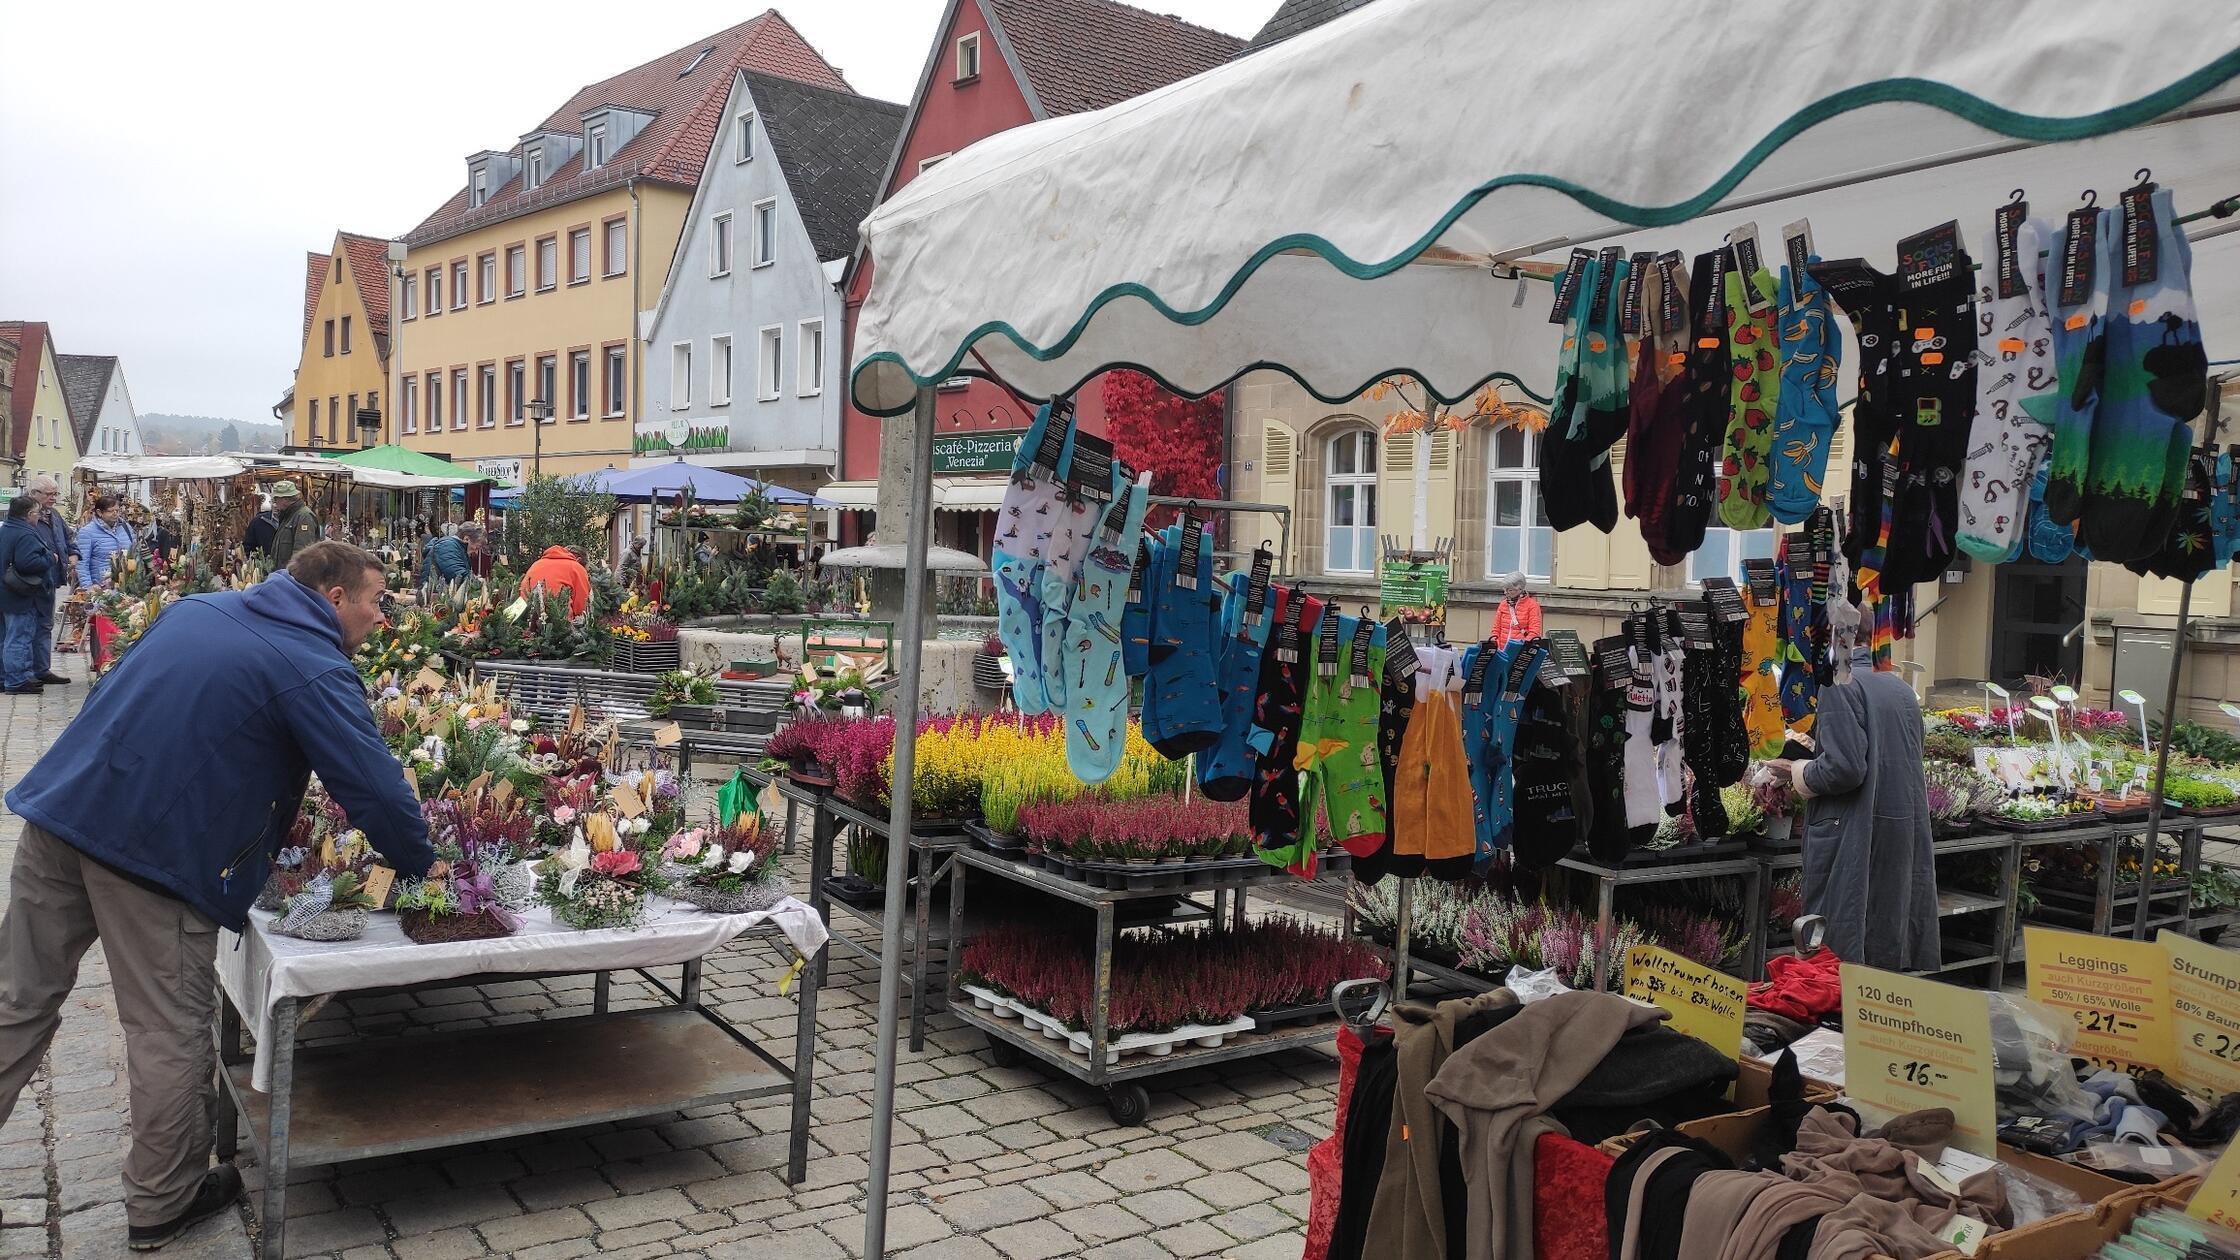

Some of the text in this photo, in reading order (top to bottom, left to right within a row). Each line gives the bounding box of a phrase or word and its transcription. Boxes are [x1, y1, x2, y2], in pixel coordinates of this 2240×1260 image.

[1907, 262, 1953, 282] MORE FUN
[1911, 280, 1922, 289] IN
[933, 439, 1011, 455] iscafé-Pizzeria
[1526, 781, 1569, 795] TRUC
[2059, 952, 2128, 974] Leggings
[2048, 974, 2143, 994] auch Kurzgrößen
[1671, 985, 1684, 998] bis
[1711, 1000, 1736, 1019] Wolle
[1857, 984, 1913, 1008] 120 den
[2051, 989, 2074, 1001] 50%
[2083, 994, 2106, 1007] 65%
[2109, 998, 2141, 1012] Wolle
[2176, 999, 2202, 1017] 80%
[1858, 1008, 1963, 1043] Strumpfhosen
[2072, 1040, 2133, 1058] bergrößen
[2192, 1033, 2205, 1048] €
[1888, 1062, 1898, 1078] €
